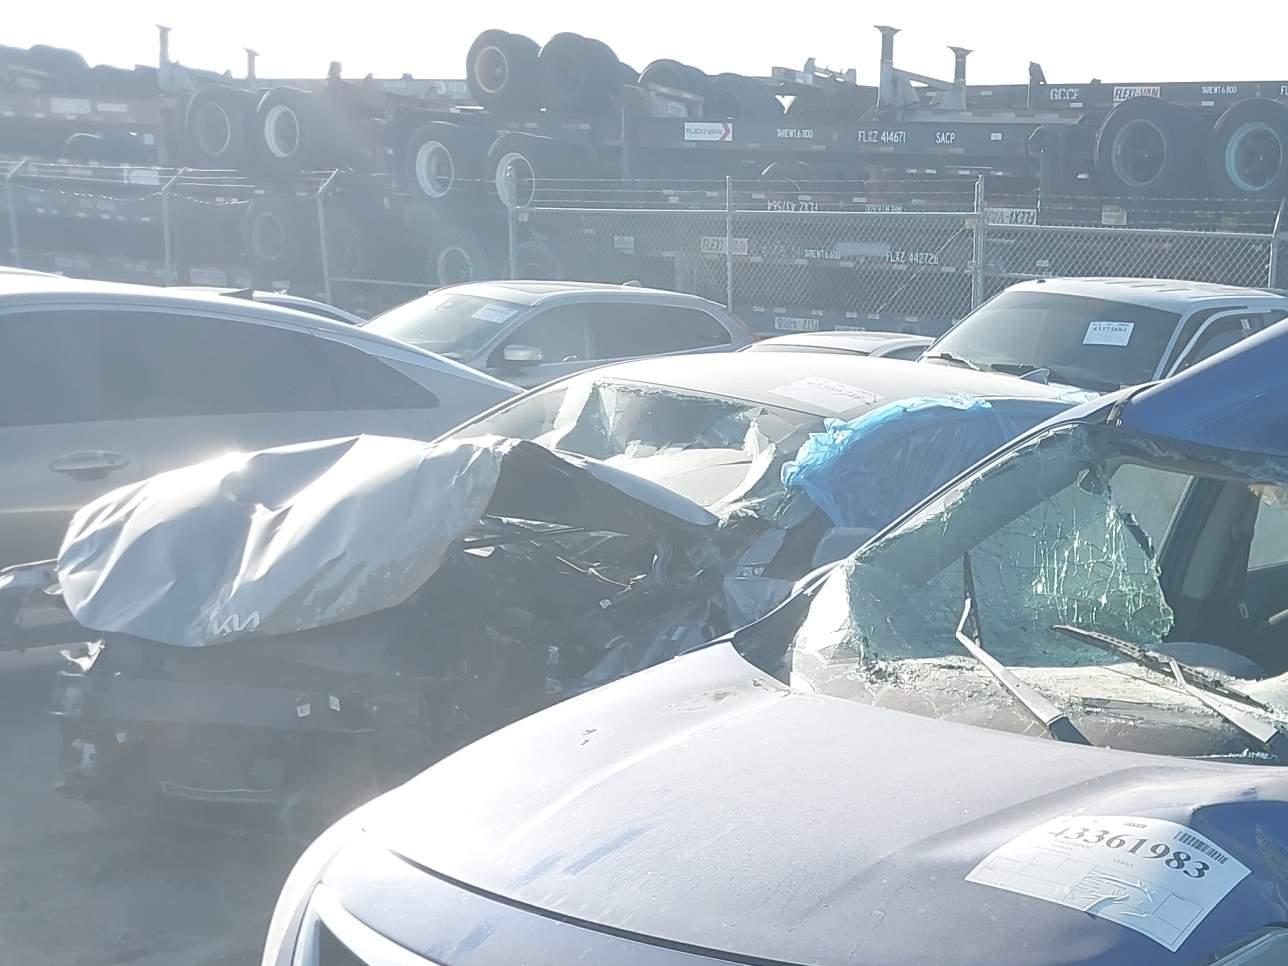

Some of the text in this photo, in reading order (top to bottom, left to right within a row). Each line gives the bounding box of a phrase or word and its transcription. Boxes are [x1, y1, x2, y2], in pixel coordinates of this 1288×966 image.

[858, 130, 907, 144] FLXZ 414671
[935, 131, 956, 144] SACP
[886, 251, 939, 265] FLXZ 442726
[1048, 827, 1211, 880] 43361983
